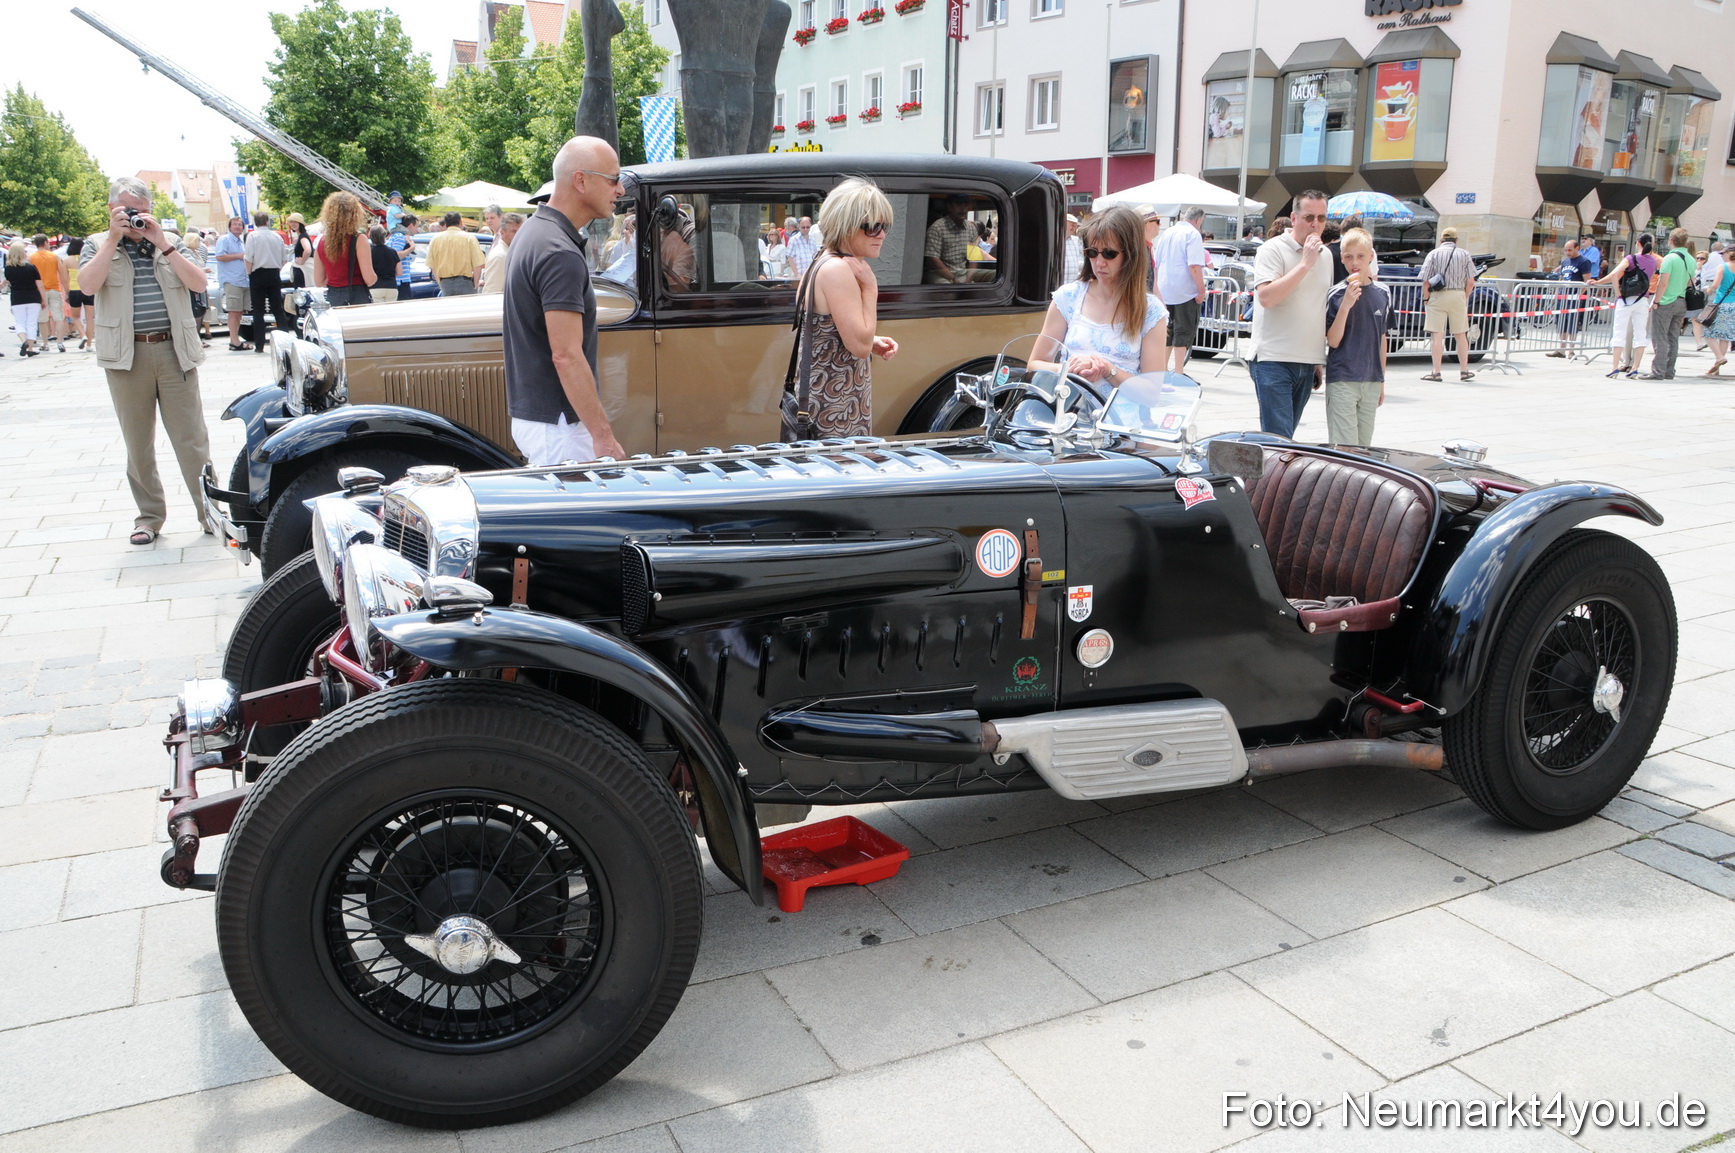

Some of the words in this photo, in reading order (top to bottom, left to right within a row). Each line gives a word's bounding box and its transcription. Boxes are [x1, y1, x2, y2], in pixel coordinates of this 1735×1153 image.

[1377, 21, 1396, 30] am
[1399, 12, 1452, 27] Rathaus
[1291, 83, 1317, 100] RACKL
[982, 535, 1016, 571] AGIP
[1004, 683, 1047, 693] KRANZ
